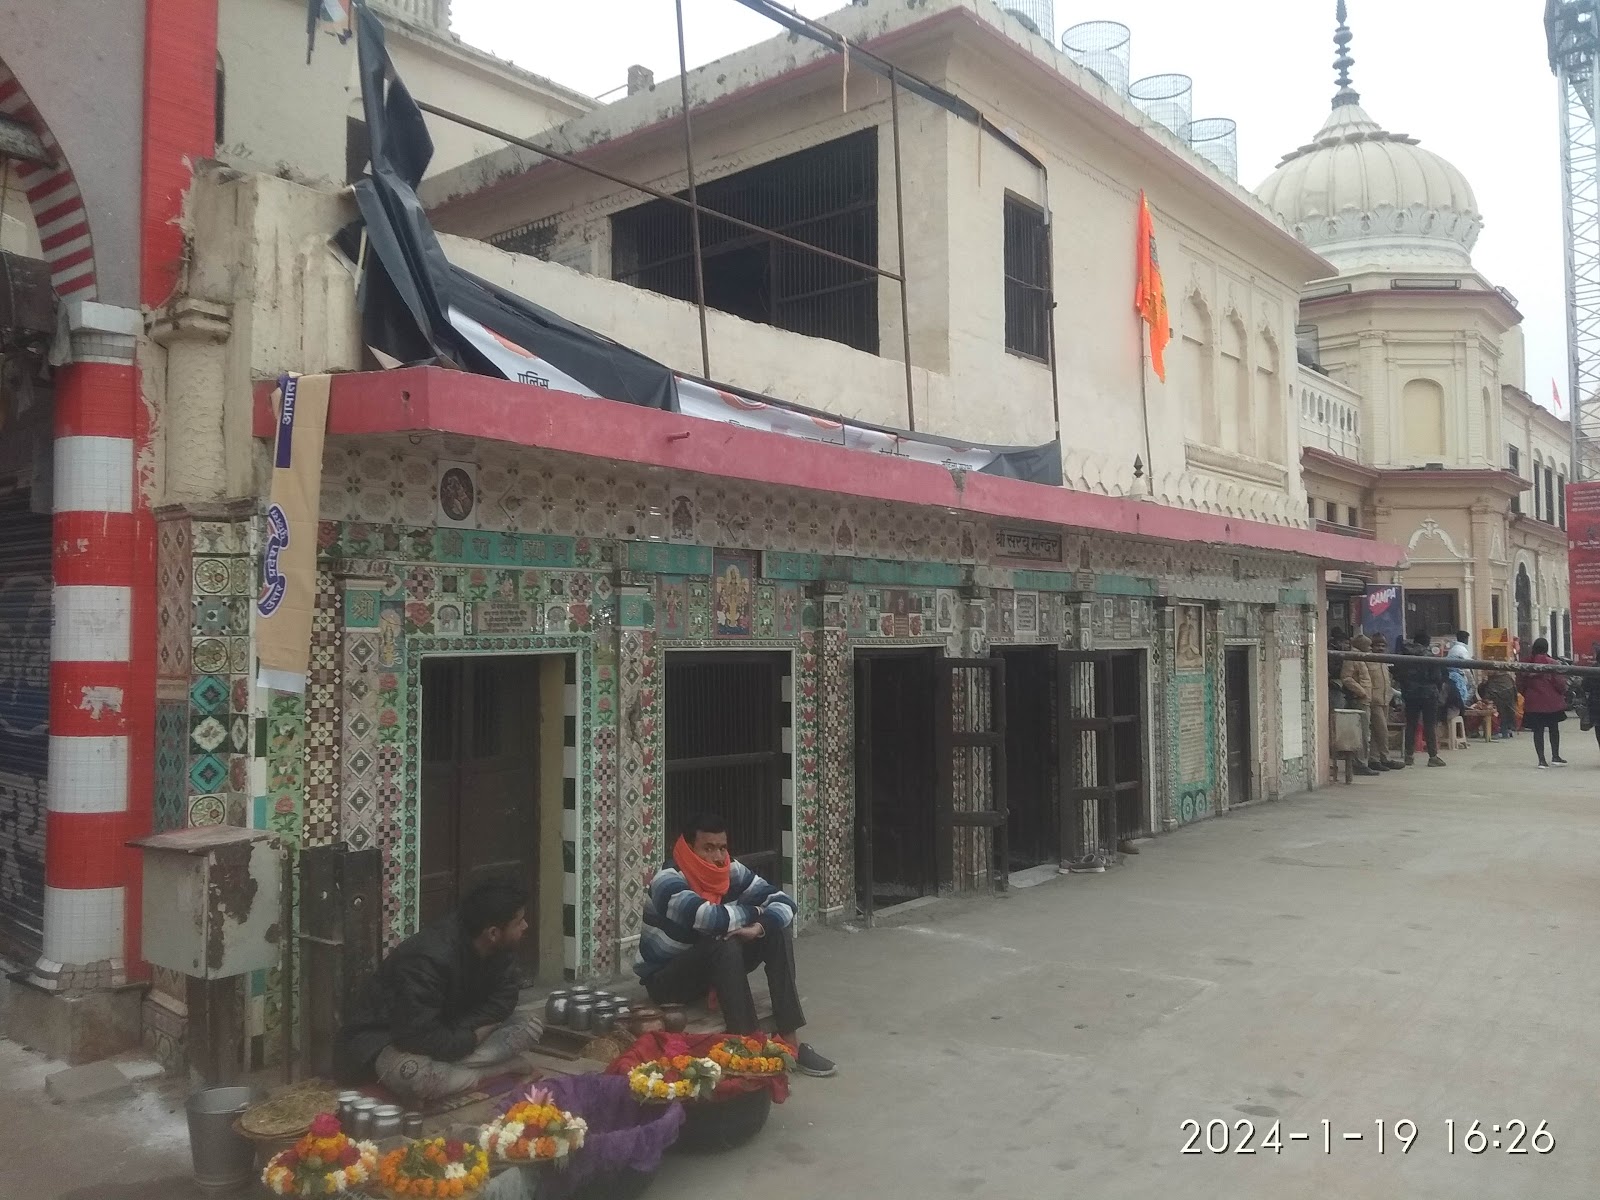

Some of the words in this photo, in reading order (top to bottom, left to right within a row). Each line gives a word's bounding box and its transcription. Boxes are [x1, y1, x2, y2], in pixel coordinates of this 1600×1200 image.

[517, 371, 550, 389] पलिस
[281, 380, 297, 426] आपात
[270, 509, 289, 540] पुलिस
[995, 529, 1006, 547] श्री
[1006, 534, 1034, 554] सरयू
[1031, 535, 1059, 553] मन्दिर
[265, 544, 280, 579] प्रदेश
[263, 584, 284, 611] उत्तर
[1369, 587, 1396, 607] CAMPA
